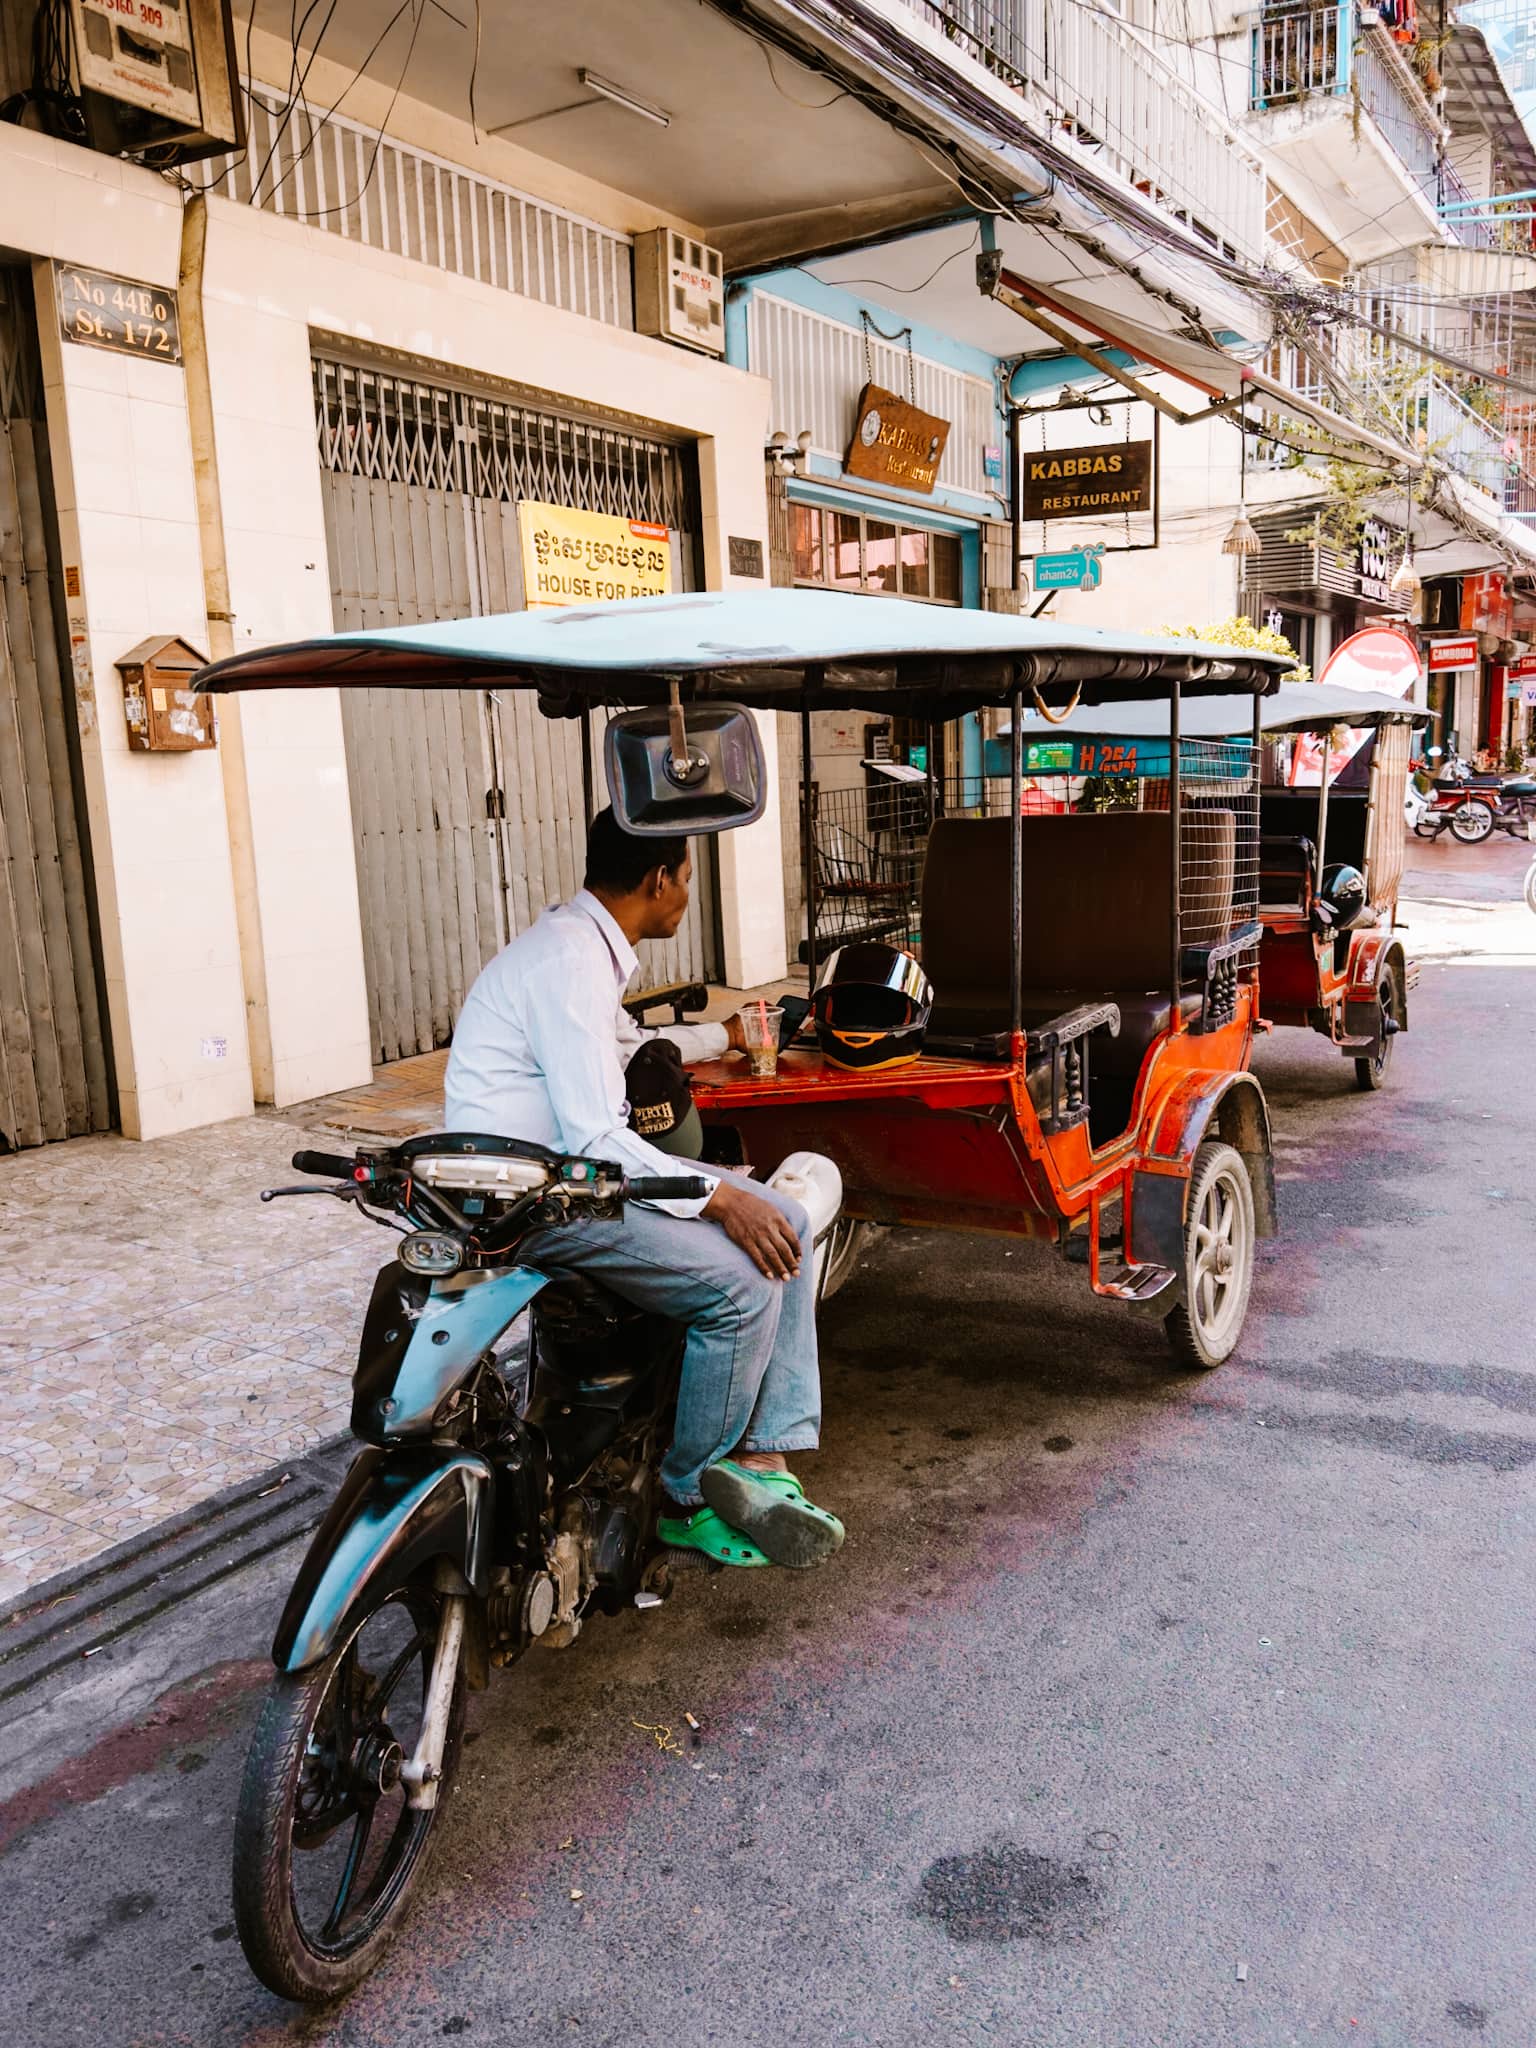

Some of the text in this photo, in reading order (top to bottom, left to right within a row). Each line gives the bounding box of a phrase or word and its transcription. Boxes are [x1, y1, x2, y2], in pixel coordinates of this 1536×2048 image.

[72, 275, 105, 306] No
[76, 308, 170, 352] St. 172
[1030, 455, 1122, 480] KABBAS
[1043, 490, 1141, 510] RESTAURANT
[537, 573, 592, 597] HOUSE
[596, 581, 625, 600] FOR
[1040, 567, 1079, 581] nham24
[1080, 745, 1096, 771] H
[1099, 745, 1137, 773] 254
